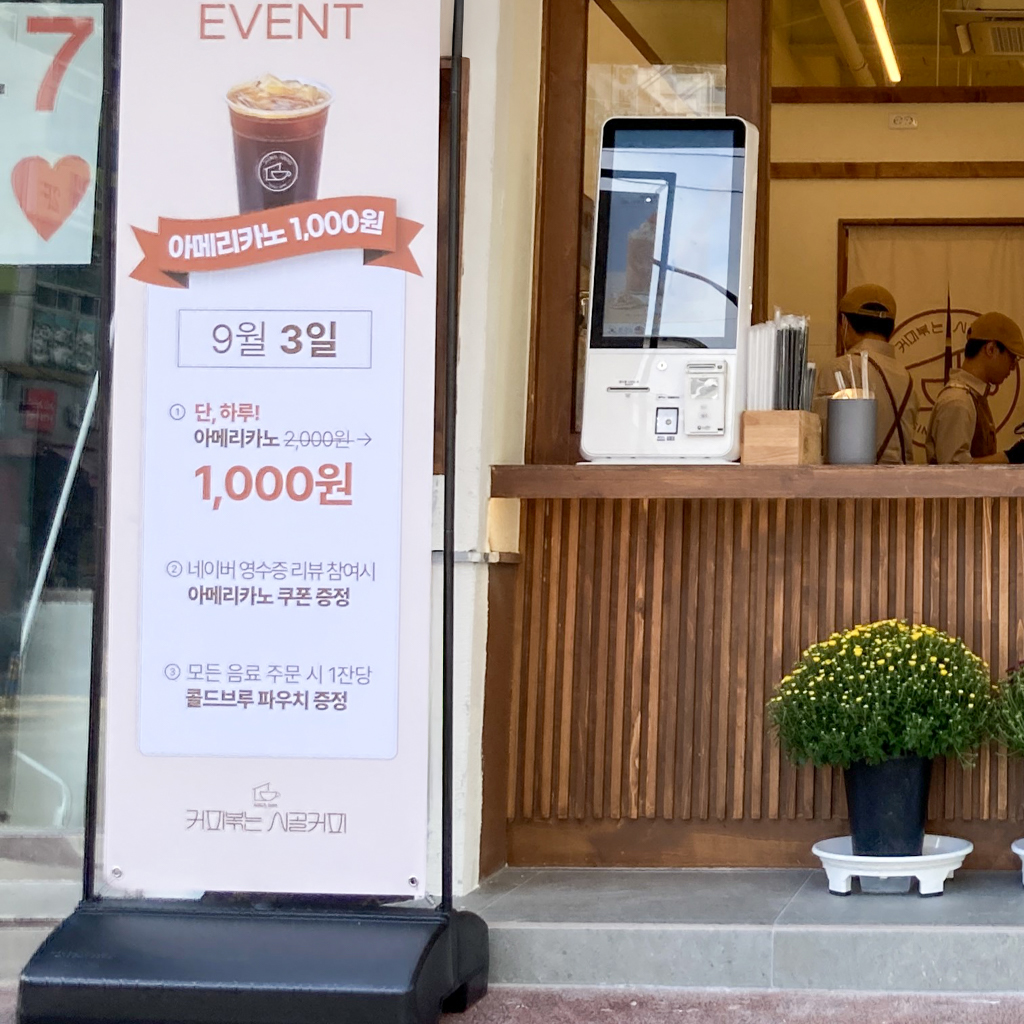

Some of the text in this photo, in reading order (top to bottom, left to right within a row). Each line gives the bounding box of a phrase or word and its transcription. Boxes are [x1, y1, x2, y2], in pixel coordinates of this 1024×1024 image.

[200, 3, 363, 39] EVENT
[26, 16, 94, 111] 7
[168, 208, 386, 260] 아메리카노 1,000원
[213, 321, 336, 357] 9월 3일
[195, 403, 216, 424] 단,
[220, 403, 259, 422] 하루!
[194, 428, 354, 450] 아메리카노 2,000원
[195, 462, 352, 510] 1,000원
[188, 560, 235, 579] 네이버
[239, 561, 288, 580] 영수증
[292, 561, 323, 580] 리뷰
[327, 562, 375, 581] 참여시
[188, 585, 349, 607] 아메리카노 쿠폰 증정
[187, 664, 221, 682] 모든
[227, 664, 261, 682] 음료
[267, 665, 301, 683] 주문
[307, 665, 322, 684] 시
[329, 666, 372, 685] 1잔당
[186, 689, 347, 711] 콜드브루 파우치 증정
[186, 809, 347, 834] 커피볶는 시골커피
